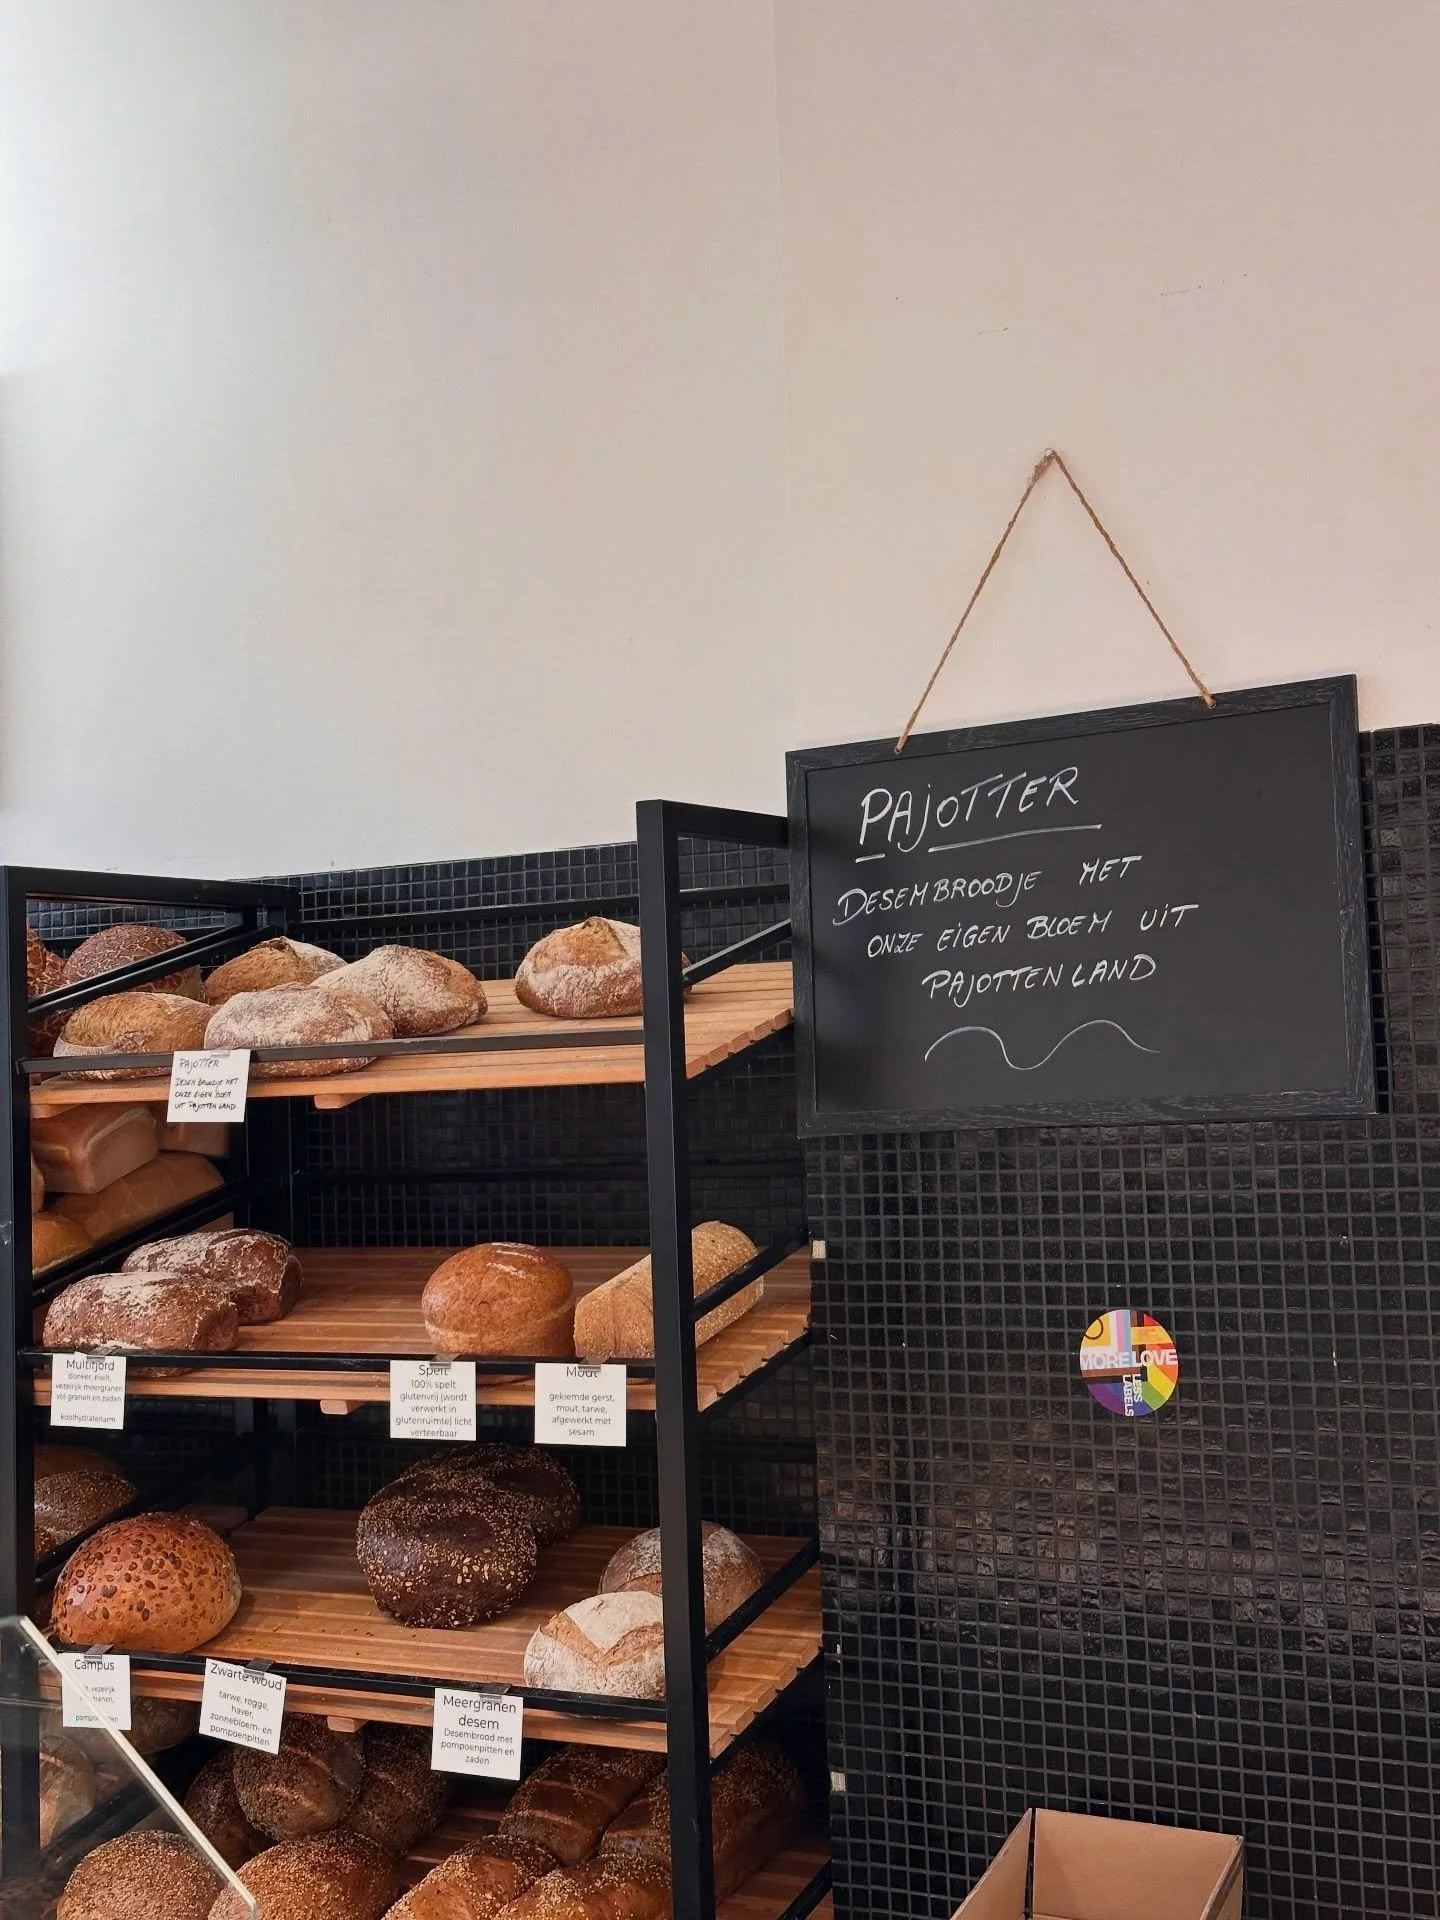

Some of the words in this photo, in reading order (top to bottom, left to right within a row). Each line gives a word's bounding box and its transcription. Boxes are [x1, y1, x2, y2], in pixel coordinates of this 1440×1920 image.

[1079, 856, 1142, 887] MET
[867, 933, 922, 958] ONZE
[1026, 911, 1112, 941] BLOEM
[1080, 1352, 1130, 1370] MORE
[1132, 1349, 1178, 1367] LOVE
[1122, 1375, 1134, 1417] LABELS
[1132, 1374, 1143, 1403] LESS
[74, 1659, 114, 1672] Campus
[443, 1695, 516, 1713] Meergranen
[459, 1715, 499, 1730] desem
[210, 1725, 269, 1746] pompoenpitten
[444, 1728, 495, 1741] Desembrood
[497, 1735, 513, 1743] met
[441, 1741, 502, 1755] pompoenpitten
[466, 1756, 489, 1764] zaden
